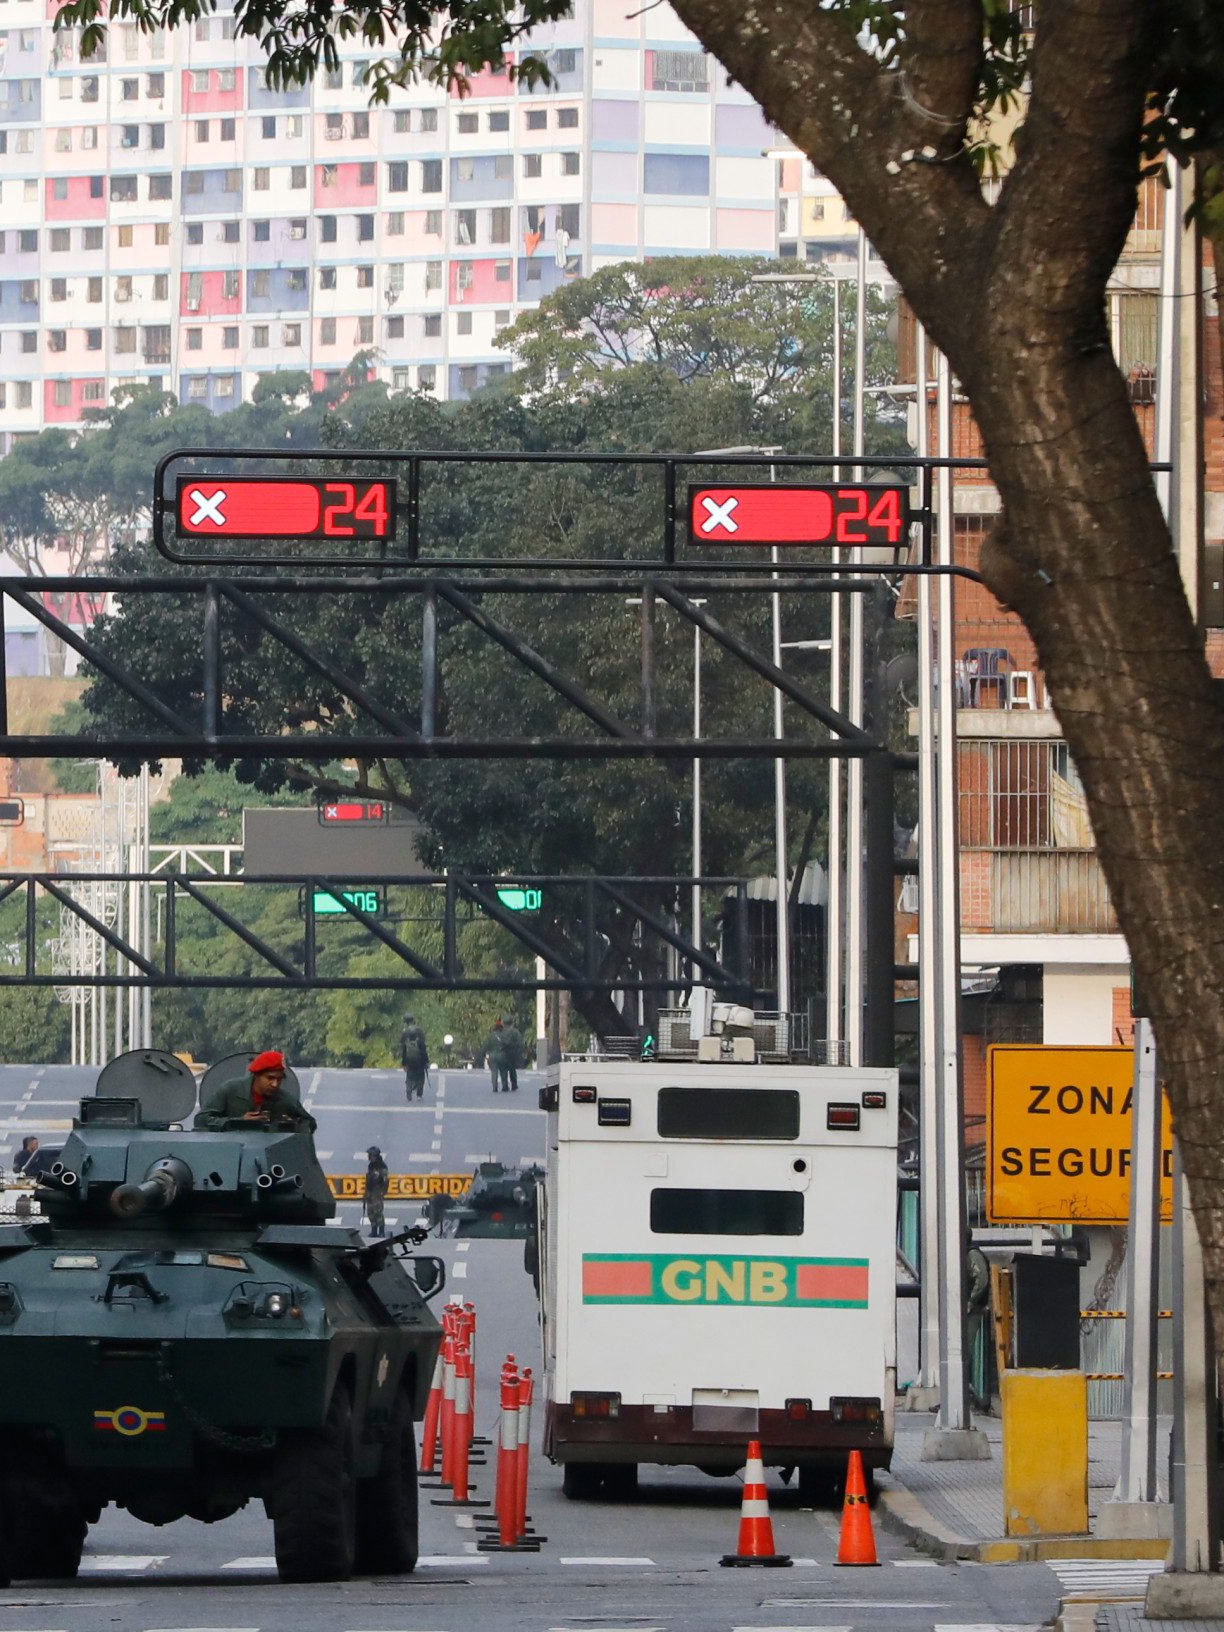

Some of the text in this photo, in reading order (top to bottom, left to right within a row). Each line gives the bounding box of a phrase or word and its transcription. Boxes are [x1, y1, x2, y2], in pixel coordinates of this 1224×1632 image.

[324, 482, 389, 536] 24
[836, 489, 902, 543] 24
[366, 803, 382, 820] 14
[661, 1260, 789, 1302] GNB
